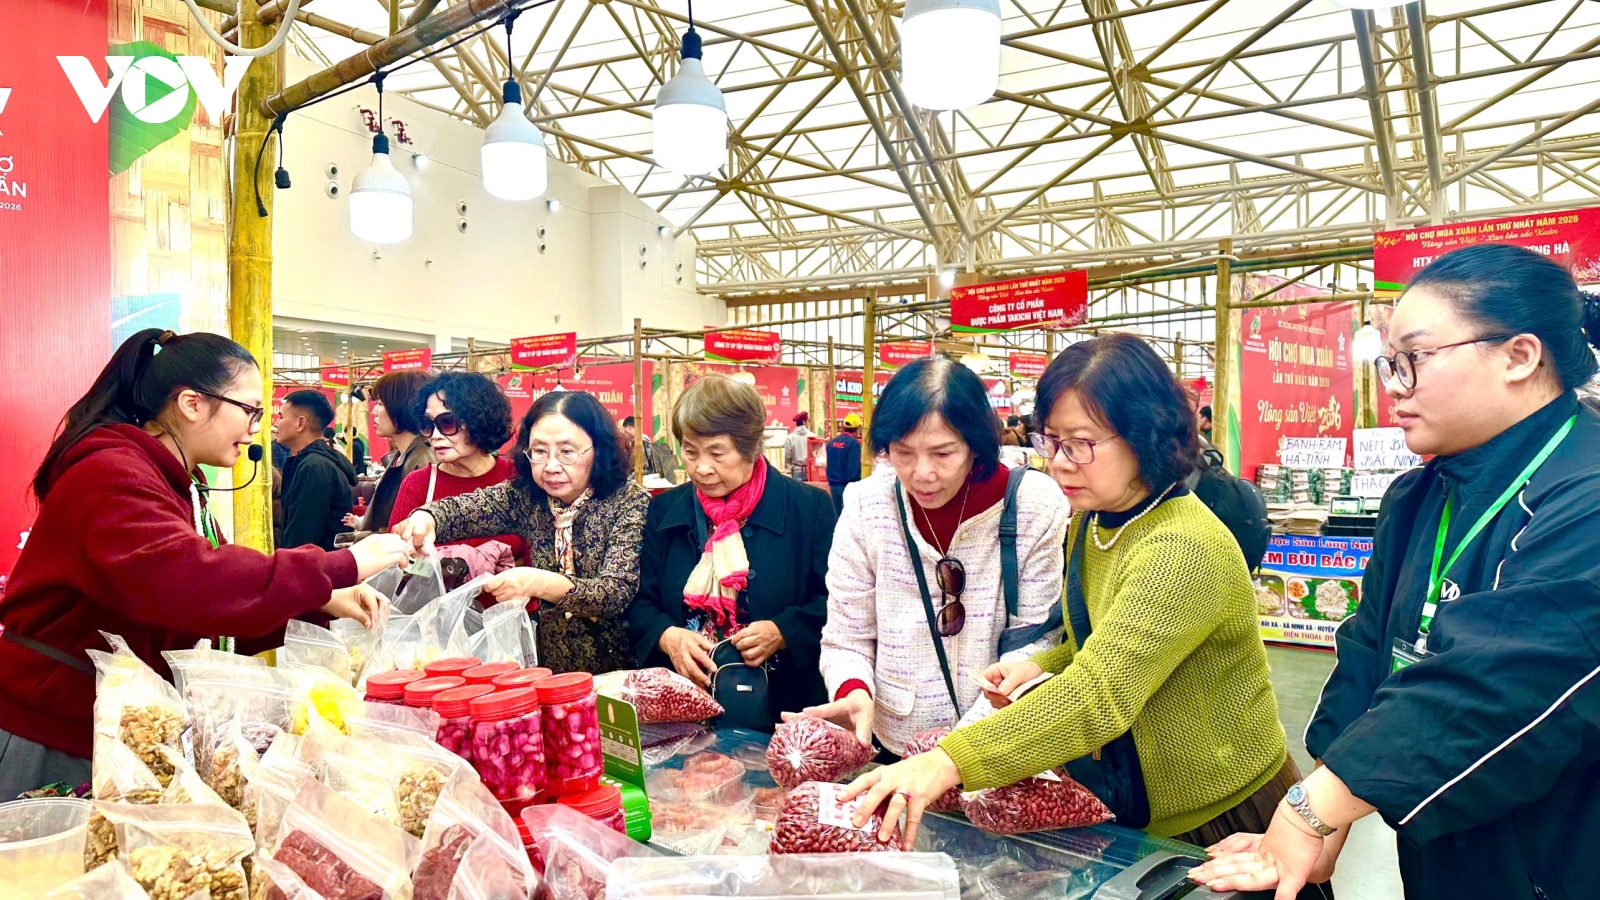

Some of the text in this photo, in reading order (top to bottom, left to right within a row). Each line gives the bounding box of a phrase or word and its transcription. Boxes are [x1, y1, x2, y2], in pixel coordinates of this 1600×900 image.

[1405, 215, 1578, 242] HỘI CHỢ MÙA XUÂN LẦN THỨ NHẤT NĂM 2026
[1421, 239, 1442, 249] Nông
[1413, 256, 1432, 268] HTX
[1554, 241, 1570, 254] HÀ
[989, 297, 1044, 314] CÔNG TY CỔ PHẦN
[988, 313, 1006, 325] PHẨM
[1007, 311, 1031, 322] TAKICHI
[1032, 309, 1047, 320] VIỆT
[1048, 308, 1063, 319] NAM
[1269, 336, 1282, 366] HỘI
[1283, 341, 1299, 368] CHỢ
[1299, 341, 1315, 367] MÙA
[1316, 344, 1334, 368] XUÂN
[836, 379, 846, 392] CÁ
[598, 389, 623, 404] XUÂN
[1257, 399, 1284, 430] Nông
[1285, 404, 1299, 423] sản
[1300, 401, 1317, 427] Việt
[1360, 440, 1384, 452] NEM
[1287, 550, 1317, 567] BÙI
[1320, 550, 1357, 569] BẮC
